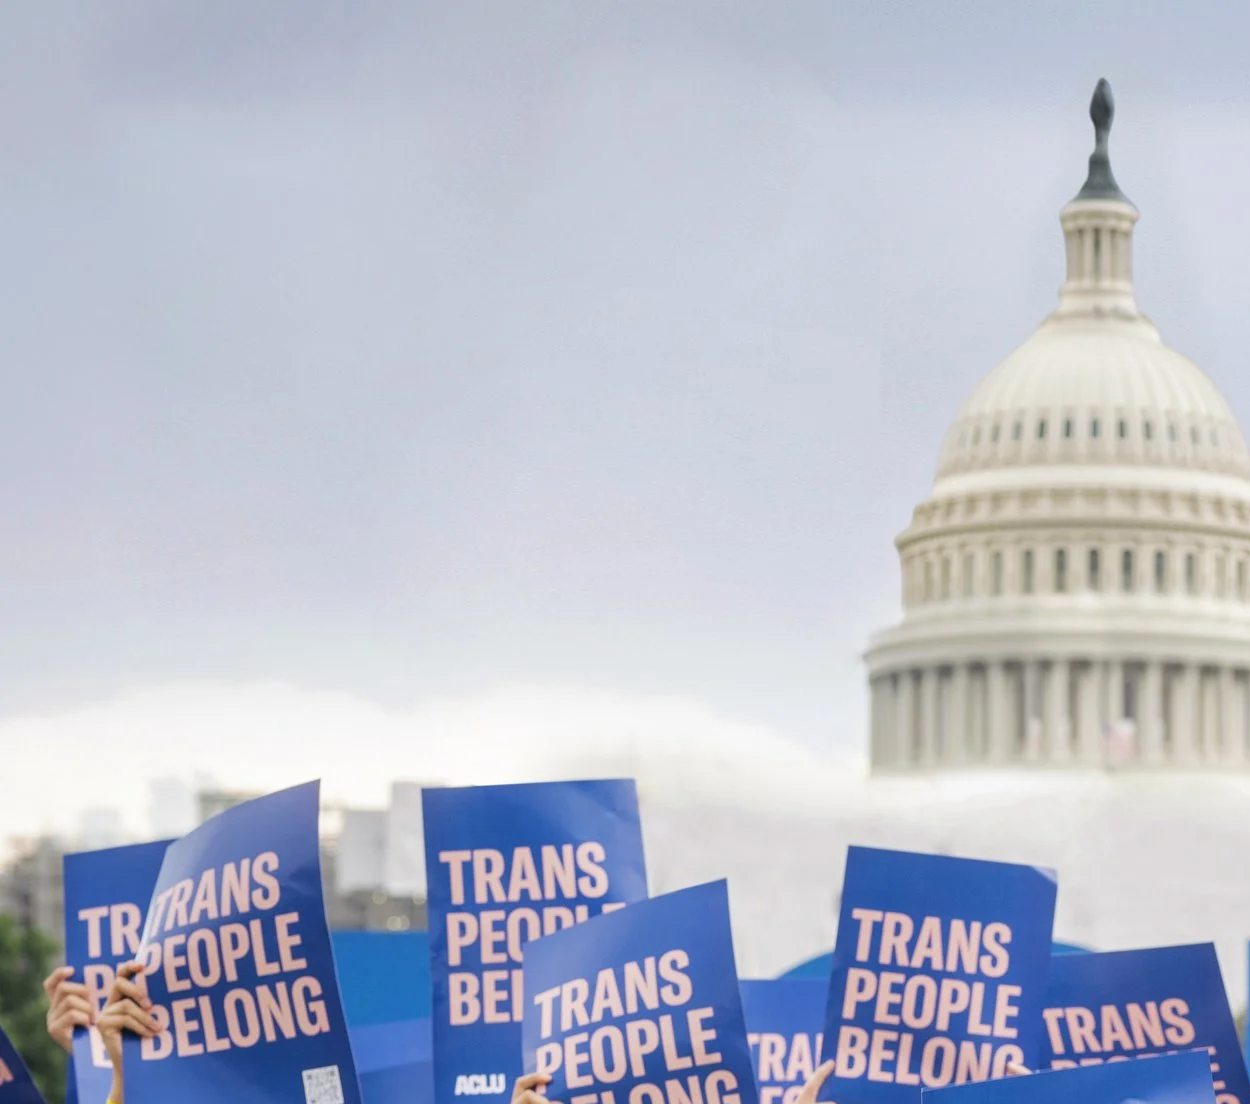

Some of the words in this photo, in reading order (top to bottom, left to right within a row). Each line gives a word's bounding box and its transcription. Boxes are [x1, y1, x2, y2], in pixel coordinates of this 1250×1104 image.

[148, 851, 281, 937] TRANS
[438, 841, 609, 905] TRANS
[138, 912, 307, 994] PEOPLE
[852, 907, 1012, 978] TRANS
[140, 976, 331, 1062] BELONG
[533, 949, 693, 1040] TRANS
[841, 967, 1022, 1039] PEOPLE
[1043, 998, 1196, 1055] TRANS
[455, 1073, 506, 1096] ACLU
[537, 1007, 722, 1093] PEOPLE
